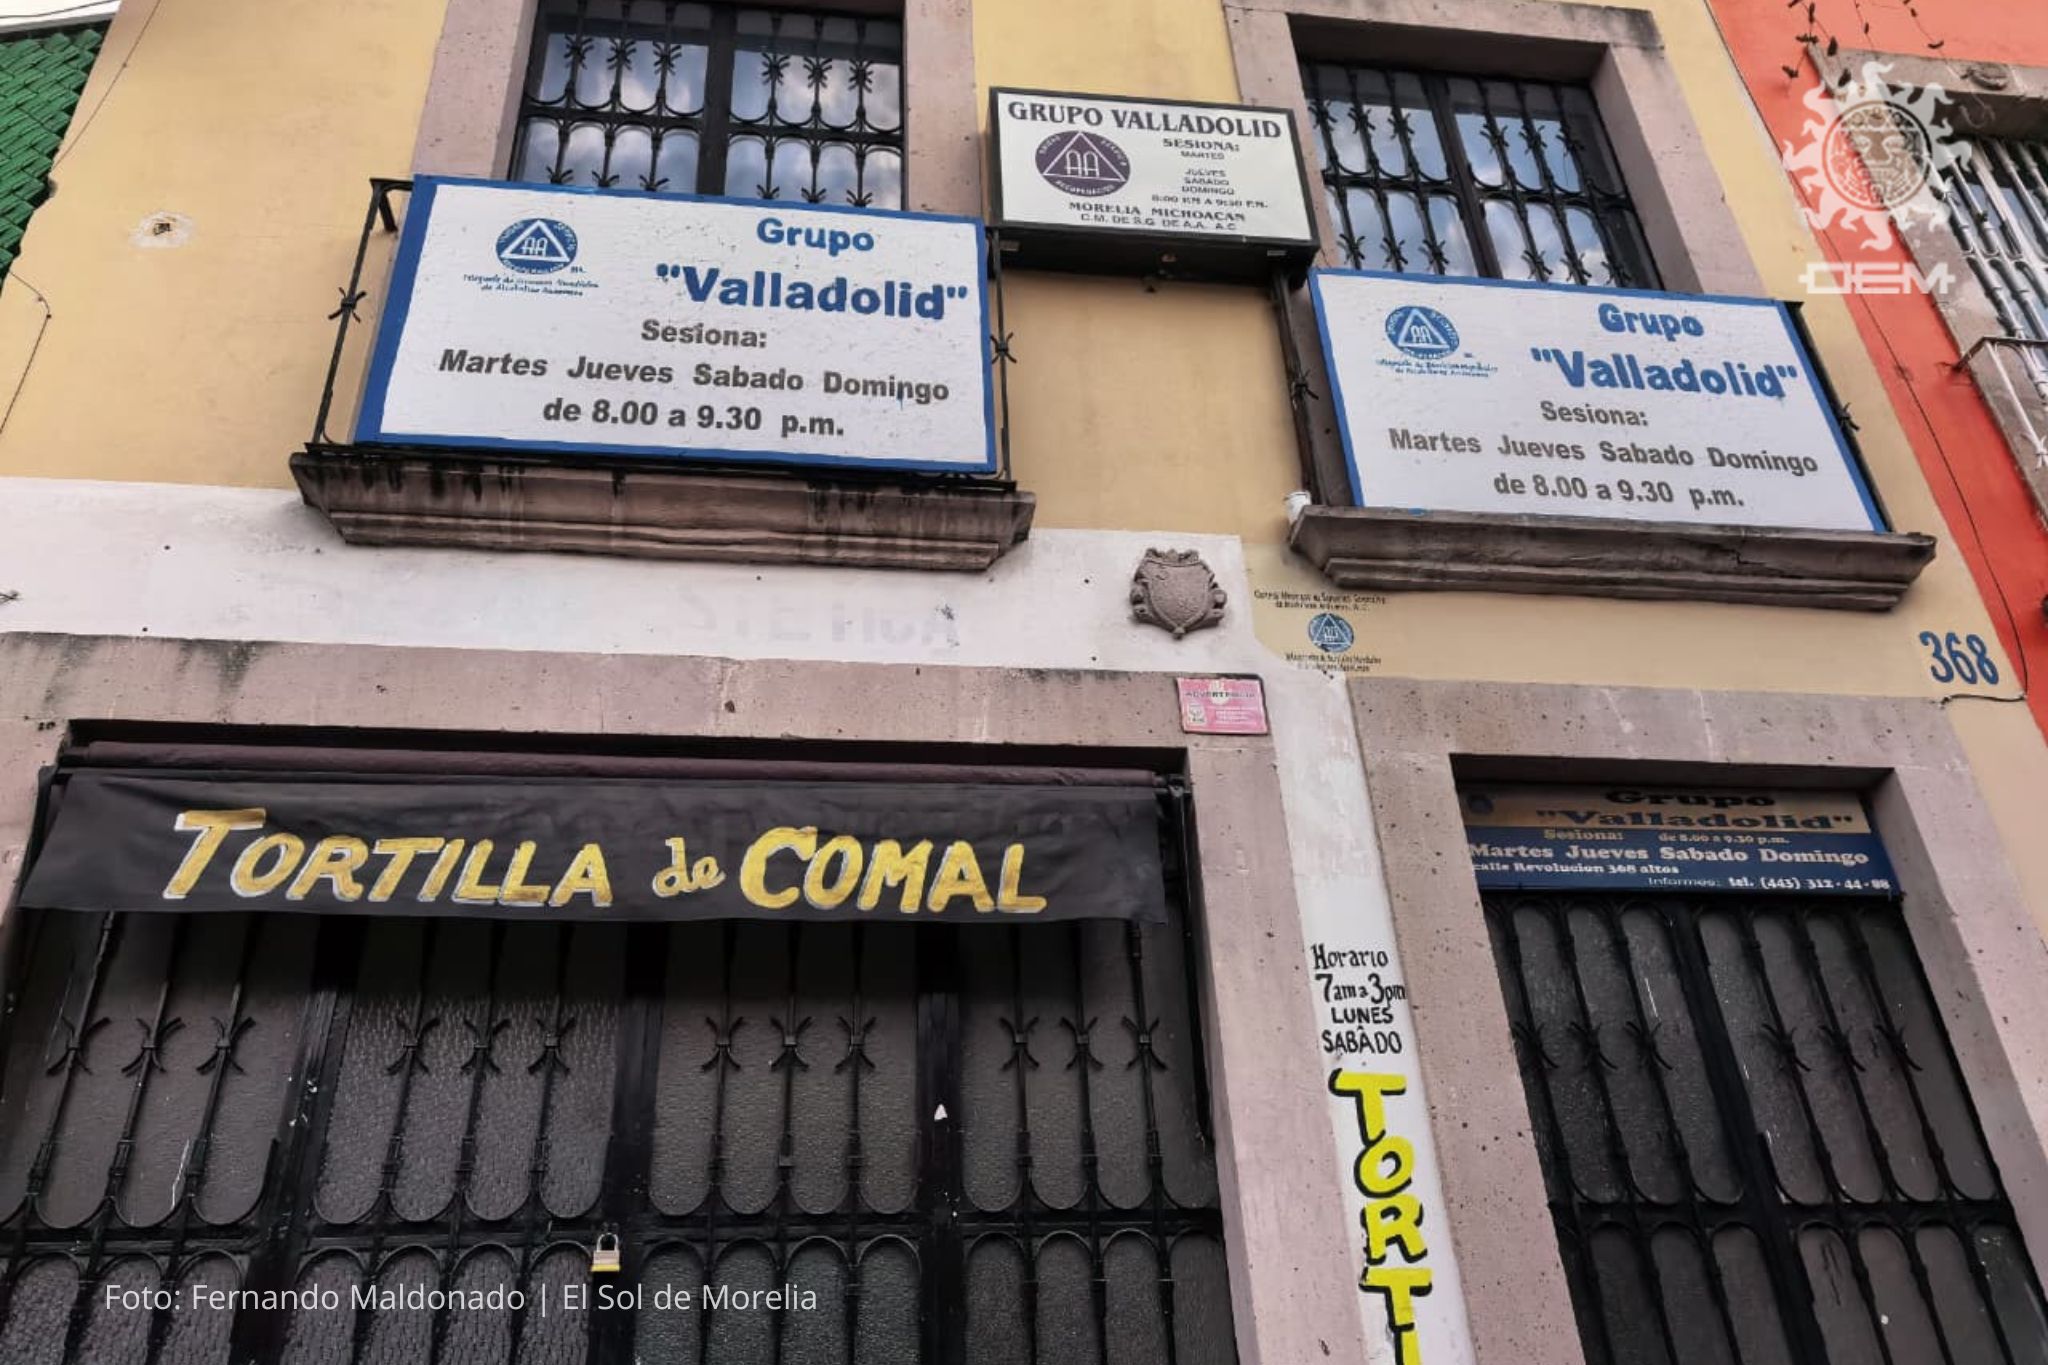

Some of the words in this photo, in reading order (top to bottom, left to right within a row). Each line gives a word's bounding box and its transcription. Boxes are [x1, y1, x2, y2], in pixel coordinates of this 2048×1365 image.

[1008, 101, 1103, 126] GRUPO
[1111, 109, 1281, 138] VALLADOLID
[1163, 138, 1240, 151] SESIONA:
[1182, 186, 1235, 195] DOMINGO
[1184, 177, 1229, 185] SABADO
[1069, 202, 1141, 215] MORELIA
[1151, 207, 1246, 221] MICHOACAN
[757, 218, 874, 255] Grupo
[656, 262, 968, 320] "Valladolid"
[641, 319, 767, 349] Sesiona:
[1599, 303, 1704, 342] Grupo
[439, 349, 547, 378] Martes
[567, 356, 673, 385] Jueves
[693, 363, 803, 393] Sabado
[823, 371, 949, 404] Domingo
[1530, 347, 1797, 399] "Valladolid"
[543, 397, 581, 423] de
[592, 401, 657, 427] 8.00
[669, 409, 685, 428] a
[698, 404, 761, 431] 9.30
[781, 414, 845, 442] p.m.
[1540, 400, 1648, 427] Sesiona:
[1389, 428, 1482, 454] Martes
[1497, 440, 1585, 462] Jueves
[1599, 441, 1694, 467] Sabado
[1707, 446, 1818, 476] Domingo
[1494, 473, 1526, 497] de
[1534, 474, 1588, 500] 8.00
[1595, 482, 1611, 501] a
[1618, 479, 1674, 505] 9.30
[1689, 486, 1744, 510] p.m.
[1919, 631, 1999, 684] 368
[1605, 789, 1776, 808] Grupo
[1536, 810, 1852, 829] "Valladolid"
[1544, 829, 1624, 841] Sesiona:
[1658, 832, 1677, 842] de
[163, 806, 613, 907] TORTILLA
[652, 838, 725, 897] de
[739, 826, 1048, 914] COMAL
[1469, 843, 1553, 858] Martes
[1565, 845, 1649, 860] Jueves
[1660, 846, 1748, 862] Sabado
[1759, 848, 1869, 867] Domingo
[1640, 864, 1679, 874] altos
[1729, 876, 1754, 888] tel.
[1760, 876, 1800, 890] (443)
[1311, 943, 1389, 969] Horario
[1315, 973, 1356, 1003] 7am
[1368, 973, 1407, 1010] 3pm
[1331, 1007, 1394, 1024] LUNES
